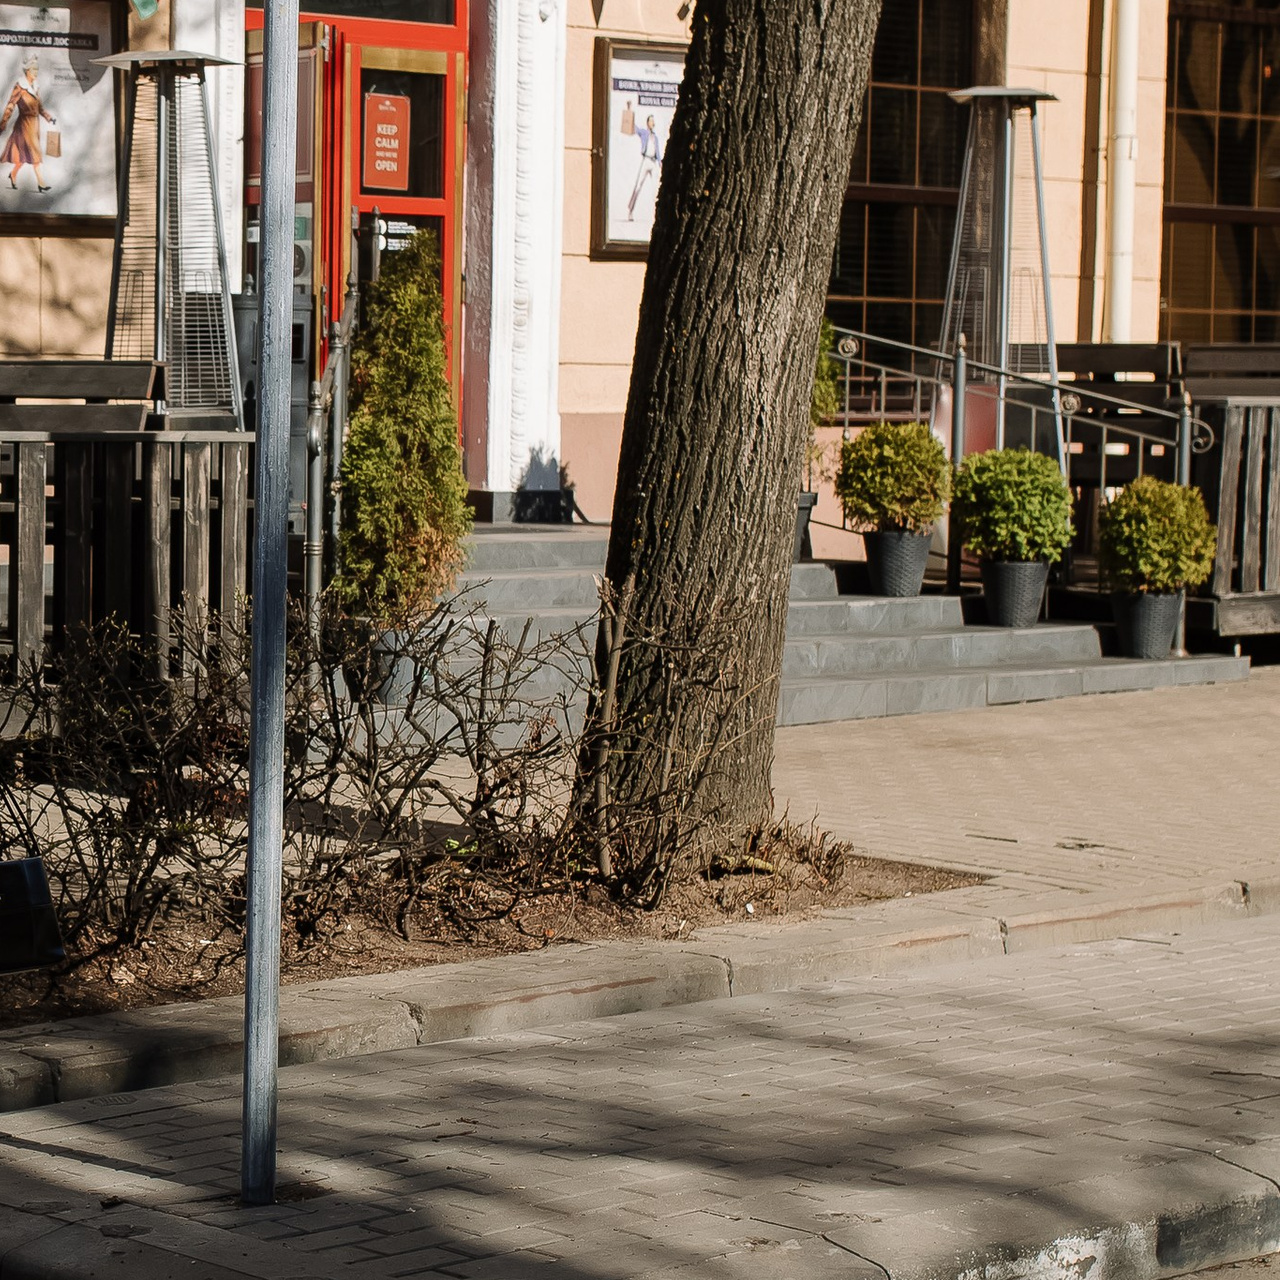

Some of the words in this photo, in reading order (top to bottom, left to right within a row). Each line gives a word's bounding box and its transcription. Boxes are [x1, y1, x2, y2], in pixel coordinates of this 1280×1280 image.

[377, 124, 398, 135] KEEP
[375, 137, 399, 149] CALM
[375, 160, 398, 172] OPEN
